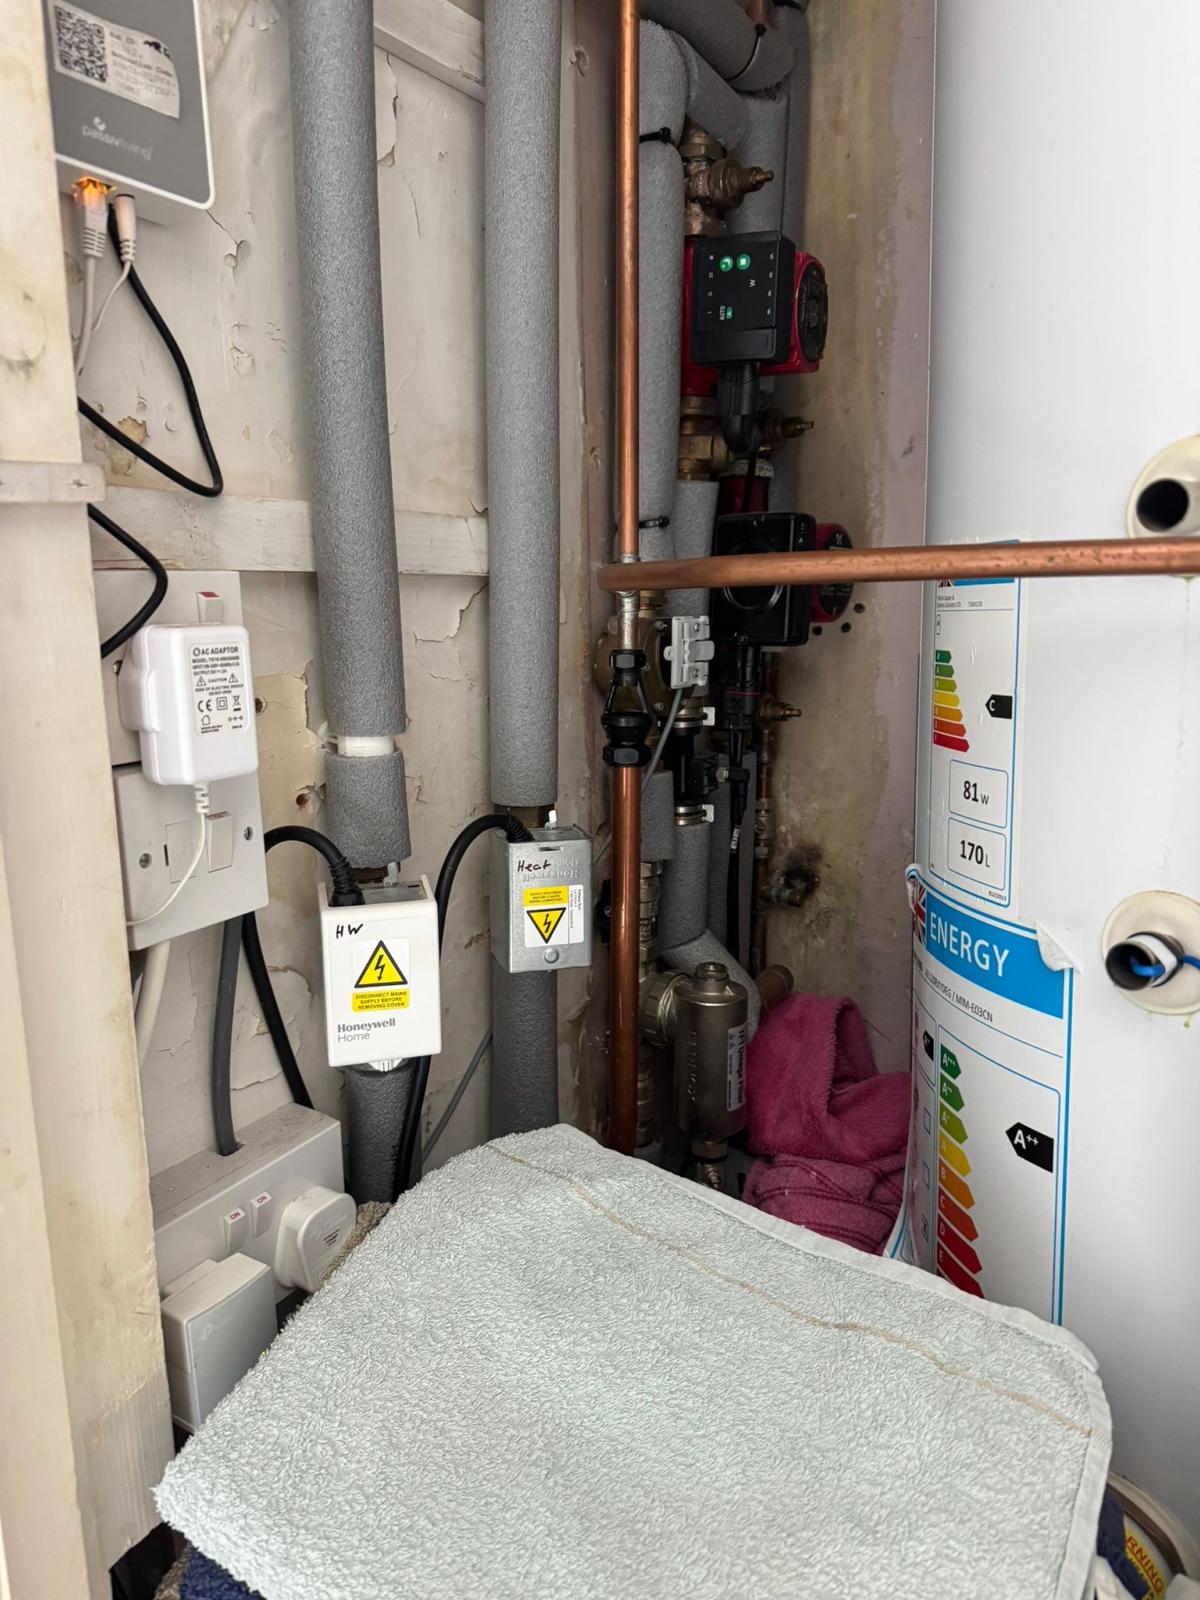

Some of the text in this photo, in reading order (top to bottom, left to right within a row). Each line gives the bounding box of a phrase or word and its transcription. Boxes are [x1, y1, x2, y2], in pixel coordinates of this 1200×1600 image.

[211, 646, 239, 655] ADAPTOR
[989, 699, 996, 712] C
[963, 780, 979, 803] 81
[959, 839, 984, 865] 170
[516, 859, 552, 872] Heat
[930, 911, 1010, 977] ENERGY
[355, 992, 390, 1000] DISCONNECT
[956, 993, 993, 1022] MIM-E03CN
[337, 1017, 396, 1032] Honeywell
[337, 1032, 371, 1043] Home
[1013, 1129, 1039, 1149] A++
[940, 1167, 946, 1179] B
[257, 1195, 268, 1204] ON
[940, 1195, 946, 1209] C
[230, 1211, 241, 1220] ON
[939, 1225, 945, 1236] D
[1125, 1536, 1164, 1594] RNING
